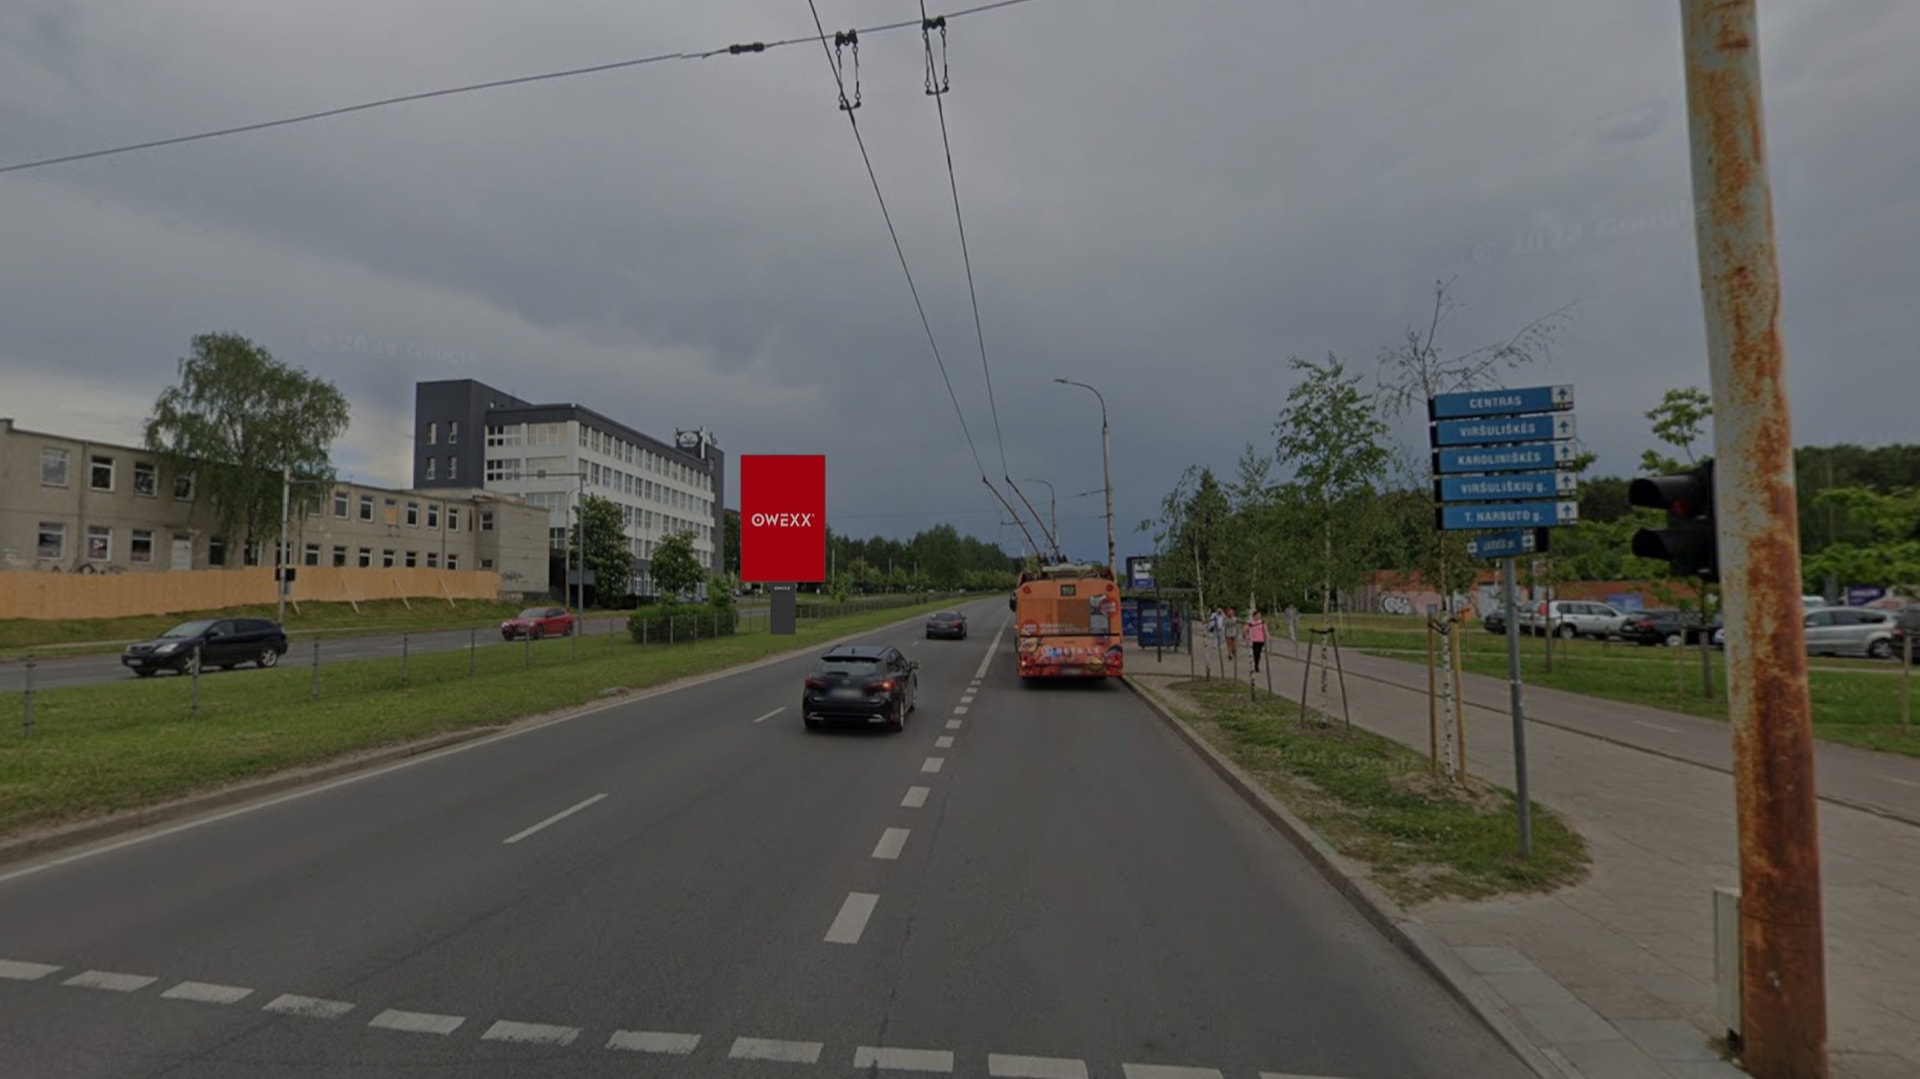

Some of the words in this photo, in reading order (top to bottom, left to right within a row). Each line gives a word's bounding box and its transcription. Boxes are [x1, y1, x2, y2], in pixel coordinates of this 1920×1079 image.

[1469, 396, 1522, 409] CENTRAS
[751, 513, 812, 527] OWEXX
[1465, 513, 1474, 522] T.
[1476, 510, 1530, 521] NARBUTO
